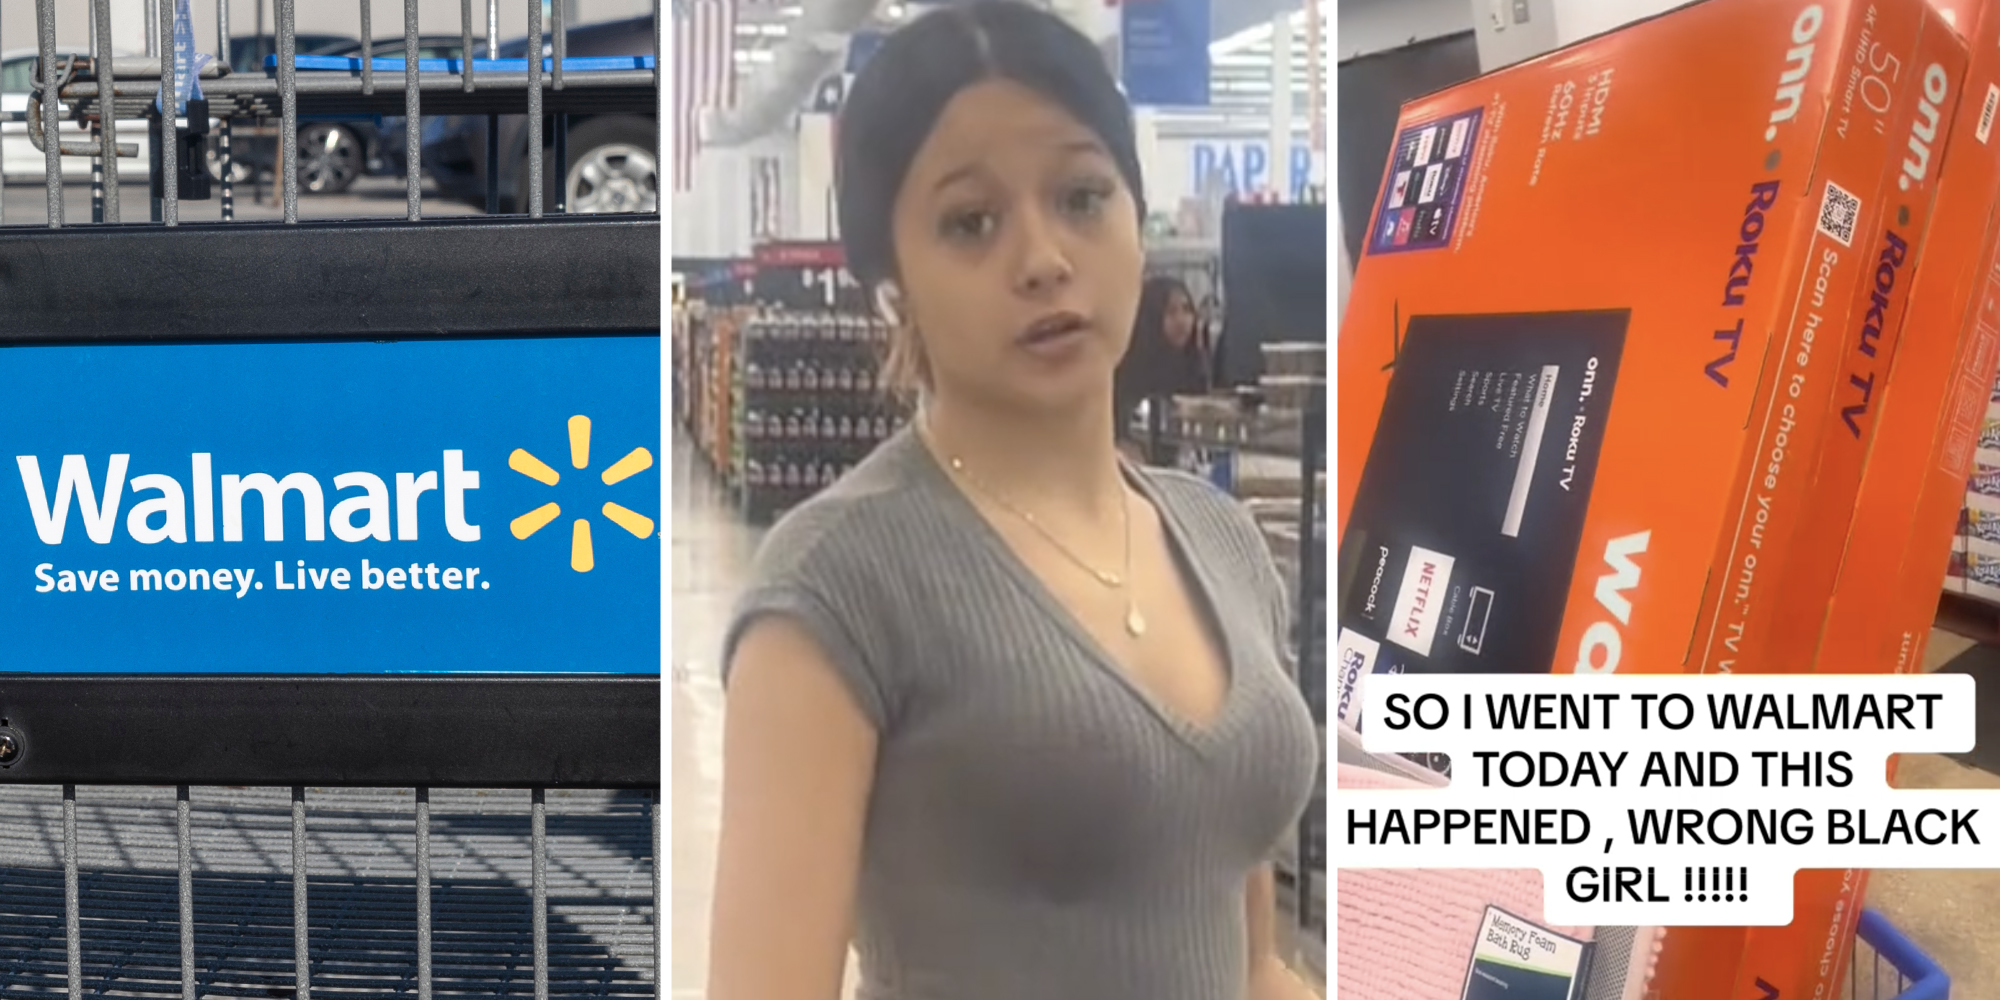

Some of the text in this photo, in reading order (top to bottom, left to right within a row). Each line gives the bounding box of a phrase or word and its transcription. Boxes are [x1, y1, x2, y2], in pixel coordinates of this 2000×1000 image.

[1764, 4, 1823, 142] onn.
[1855, 29, 1872, 64] UHD
[1551, 79, 1576, 141] 60Hz
[1585, 67, 1615, 136] HDMI
[1843, 65, 1862, 119] Smart
[1528, 83, 1562, 187] Refresh Rate
[1836, 119, 1850, 139] TV
[1898, 62, 1947, 191] onn.
[1192, 142, 1312, 200] PAPR
[1811, 247, 1838, 308] Scan
[1704, 318, 1744, 389] TV
[1796, 312, 1823, 367] here
[1448, 370, 1466, 412] Settings
[1464, 370, 1480, 407] Search
[1477, 371, 1493, 406] Sports
[1491, 372, 1508, 413] Live TV
[1538, 373, 1552, 408] Home
[1578, 356, 1598, 403] onn.
[1789, 373, 1805, 398] to
[1841, 371, 1875, 440] TV
[1496, 372, 1522, 450] Featured Free
[1509, 373, 1537, 459] What to Watch
[1764, 403, 1796, 490] choose
[16, 449, 481, 545] Walmart
[1559, 465, 1576, 492] TV
[1750, 493, 1772, 550] your
[34, 559, 490, 599] Save money. Live better.
[1364, 545, 1389, 613] peacock
[1404, 561, 1437, 638] NETFLIX
[1442, 585, 1461, 636] Cable Box
[1724, 621, 1745, 653] TV
[1486, 928, 1532, 961] Bath Rug
[1491, 913, 1557, 954] Memory Foam
[1820, 899, 1845, 977] choose
